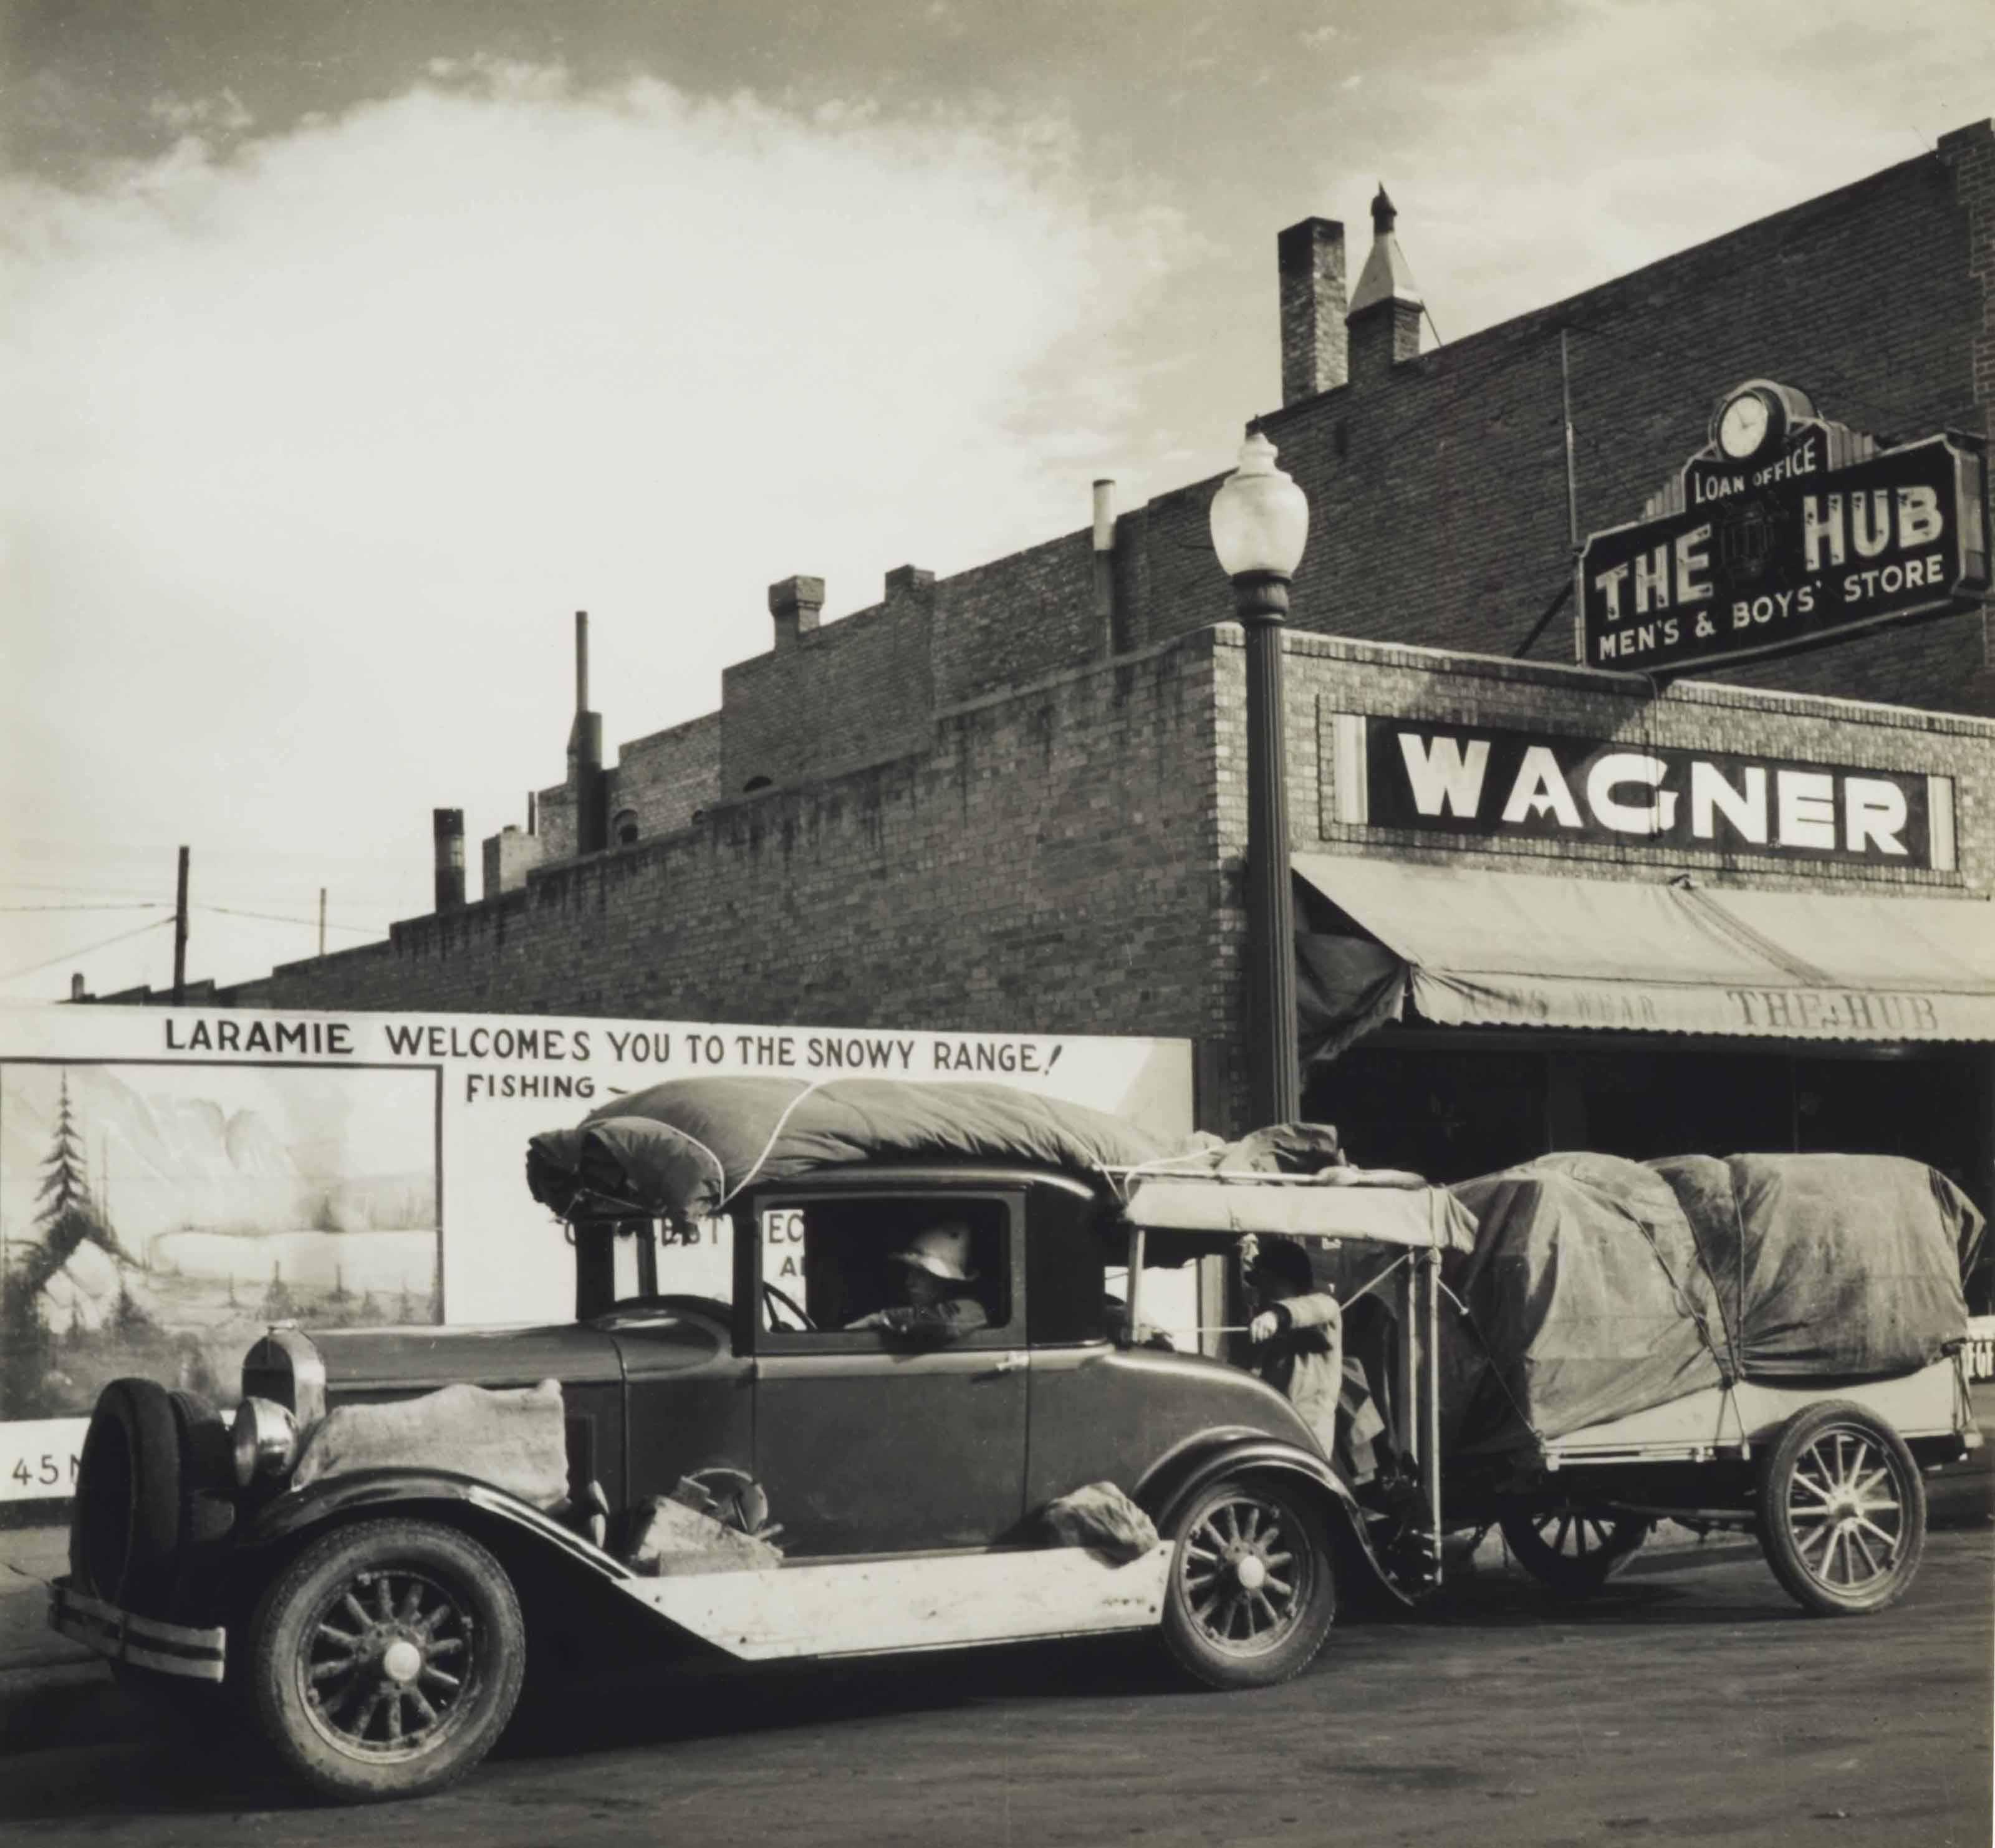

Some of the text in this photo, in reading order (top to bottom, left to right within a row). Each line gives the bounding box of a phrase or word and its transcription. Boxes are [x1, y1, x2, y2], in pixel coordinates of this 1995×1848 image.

[1695, 438, 1816, 504] LOAN OFFICE
[1595, 485, 1943, 621] THE HUB
[1599, 618, 1679, 660] MEN'S
[1696, 611, 1715, 638] &
[1844, 554, 1943, 602] STORE
[1398, 733, 1908, 855] WAGNER
[1841, 994, 1939, 1031] HUB
[165, 1018, 1062, 1076] LARAMIE WELCOMES YOU TO THE SNOWY RANGE!
[466, 1074, 595, 1102] FISHING
